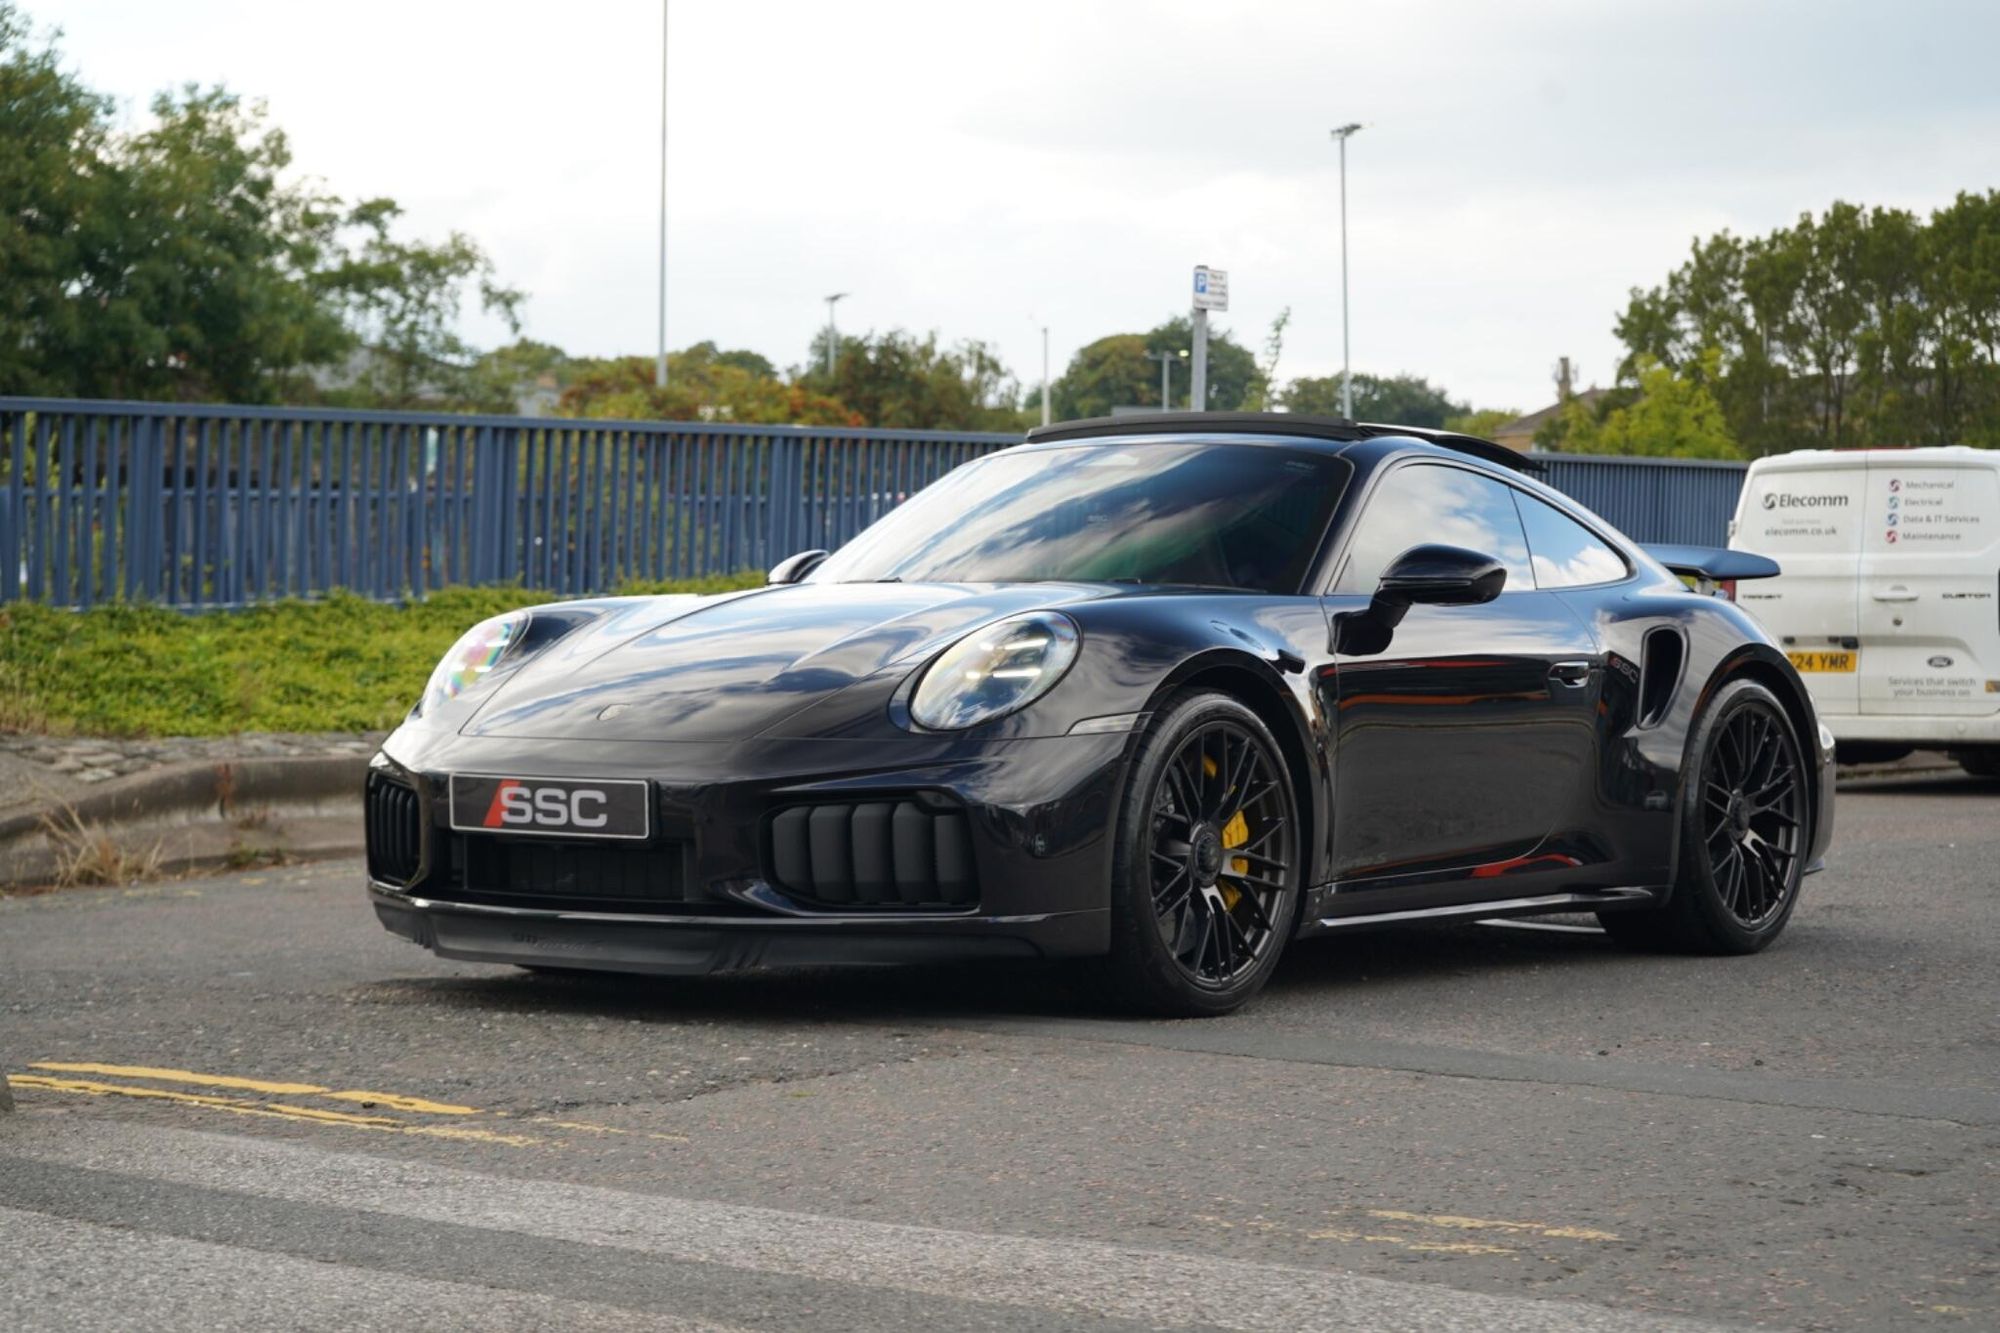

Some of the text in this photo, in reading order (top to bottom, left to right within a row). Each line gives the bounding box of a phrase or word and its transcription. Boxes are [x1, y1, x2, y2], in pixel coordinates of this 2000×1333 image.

[1906, 481, 1954, 489] Mechanical
[1779, 493, 1849, 508] Elecomm
[1904, 498, 1943, 507] Electrical
[1903, 515, 1924, 523] Data
[1934, 515, 1942, 523] IT
[1945, 515, 1980, 523] Services
[1764, 526, 1837, 537] elecomm.co.uk
[1902, 532, 1961, 540] Maintenance
[1820, 653, 1849, 670] YMR
[1888, 676, 1976, 686] Services that switch
[1894, 689, 1914, 698] your
[1916, 688, 1956, 696] business
[501, 786, 608, 827] SSC
